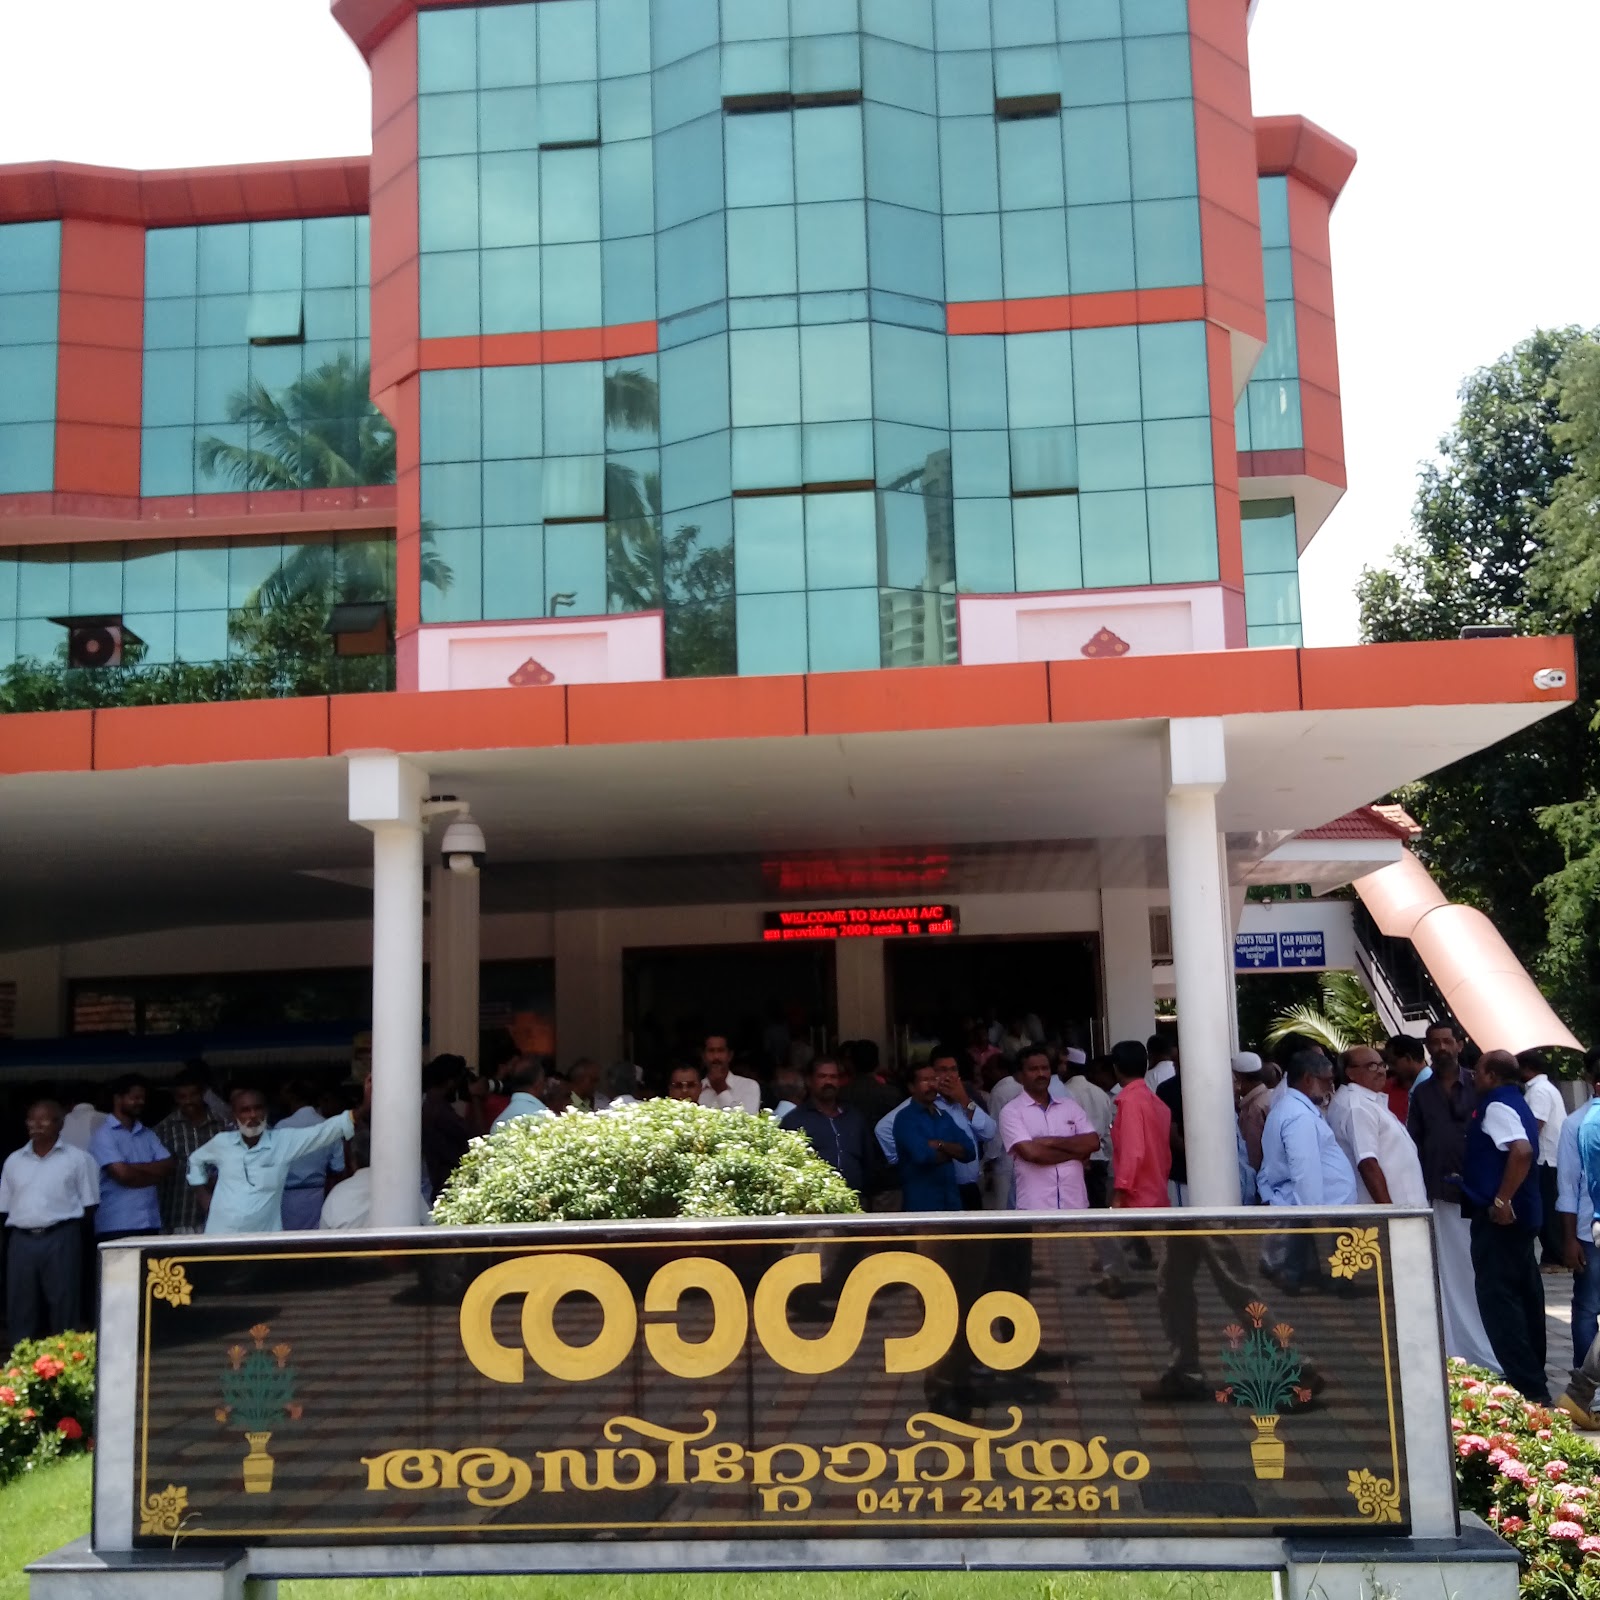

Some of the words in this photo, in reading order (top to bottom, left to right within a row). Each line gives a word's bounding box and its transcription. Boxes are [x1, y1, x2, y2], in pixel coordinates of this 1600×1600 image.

[780, 910, 847, 925] WELCOME
[849, 909, 868, 923] TO
[869, 907, 917, 922] RAGAM
[920, 906, 943, 919] A/C
[783, 925, 837, 940] providing
[839, 923, 870, 937] 2000
[873, 922, 902, 936] seats
[907, 921, 920, 934] in
[928, 919, 952, 933] audi
[1236, 935, 1255, 945] GENTS
[1255, 934, 1274, 944] TOILET
[1282, 935, 1294, 945] CAR
[1296, 934, 1321, 945] PARKING
[459, 1251, 1041, 1383] രാഗം
[360, 1406, 1150, 1512] ആഡിറ്റോറിയം
[856, 1487, 944, 1514] 0471
[961, 1485, 1120, 1513] 2412361
